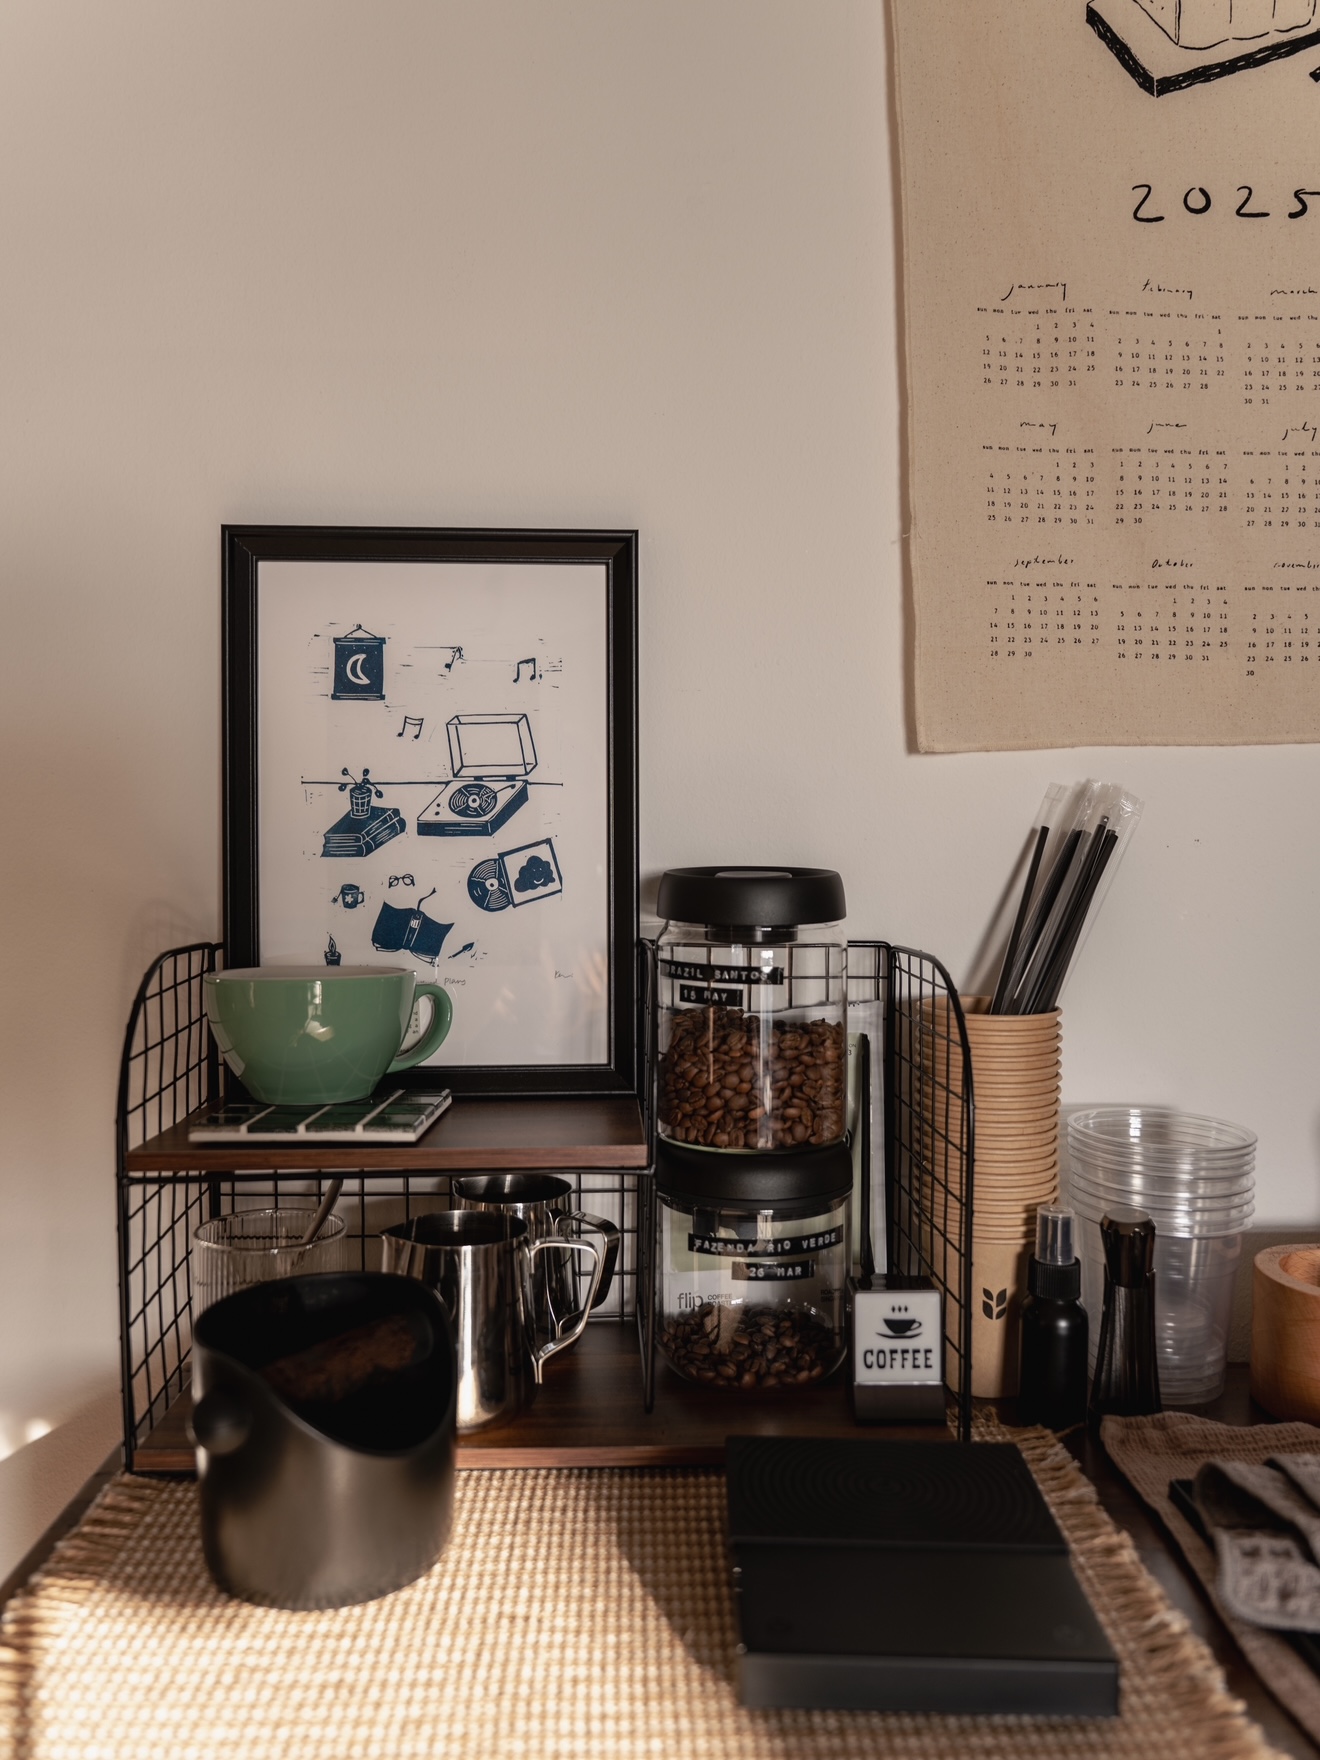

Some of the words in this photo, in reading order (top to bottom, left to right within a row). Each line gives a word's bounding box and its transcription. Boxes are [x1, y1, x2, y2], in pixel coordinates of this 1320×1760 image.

[1132, 184, 1320, 223] 2025
[1019, 421, 1059, 437] may
[713, 969, 768, 981] SANTOS
[703, 990, 728, 1002] MAY
[694, 1238, 755, 1253] FAZENDA
[766, 1241, 791, 1253] RIO
[802, 1232, 836, 1250] VERDE
[749, 1268, 765, 1278] 26
[777, 1266, 802, 1277] MAR
[677, 1292, 704, 1311] flip
[863, 1348, 934, 1369] COFFEE
